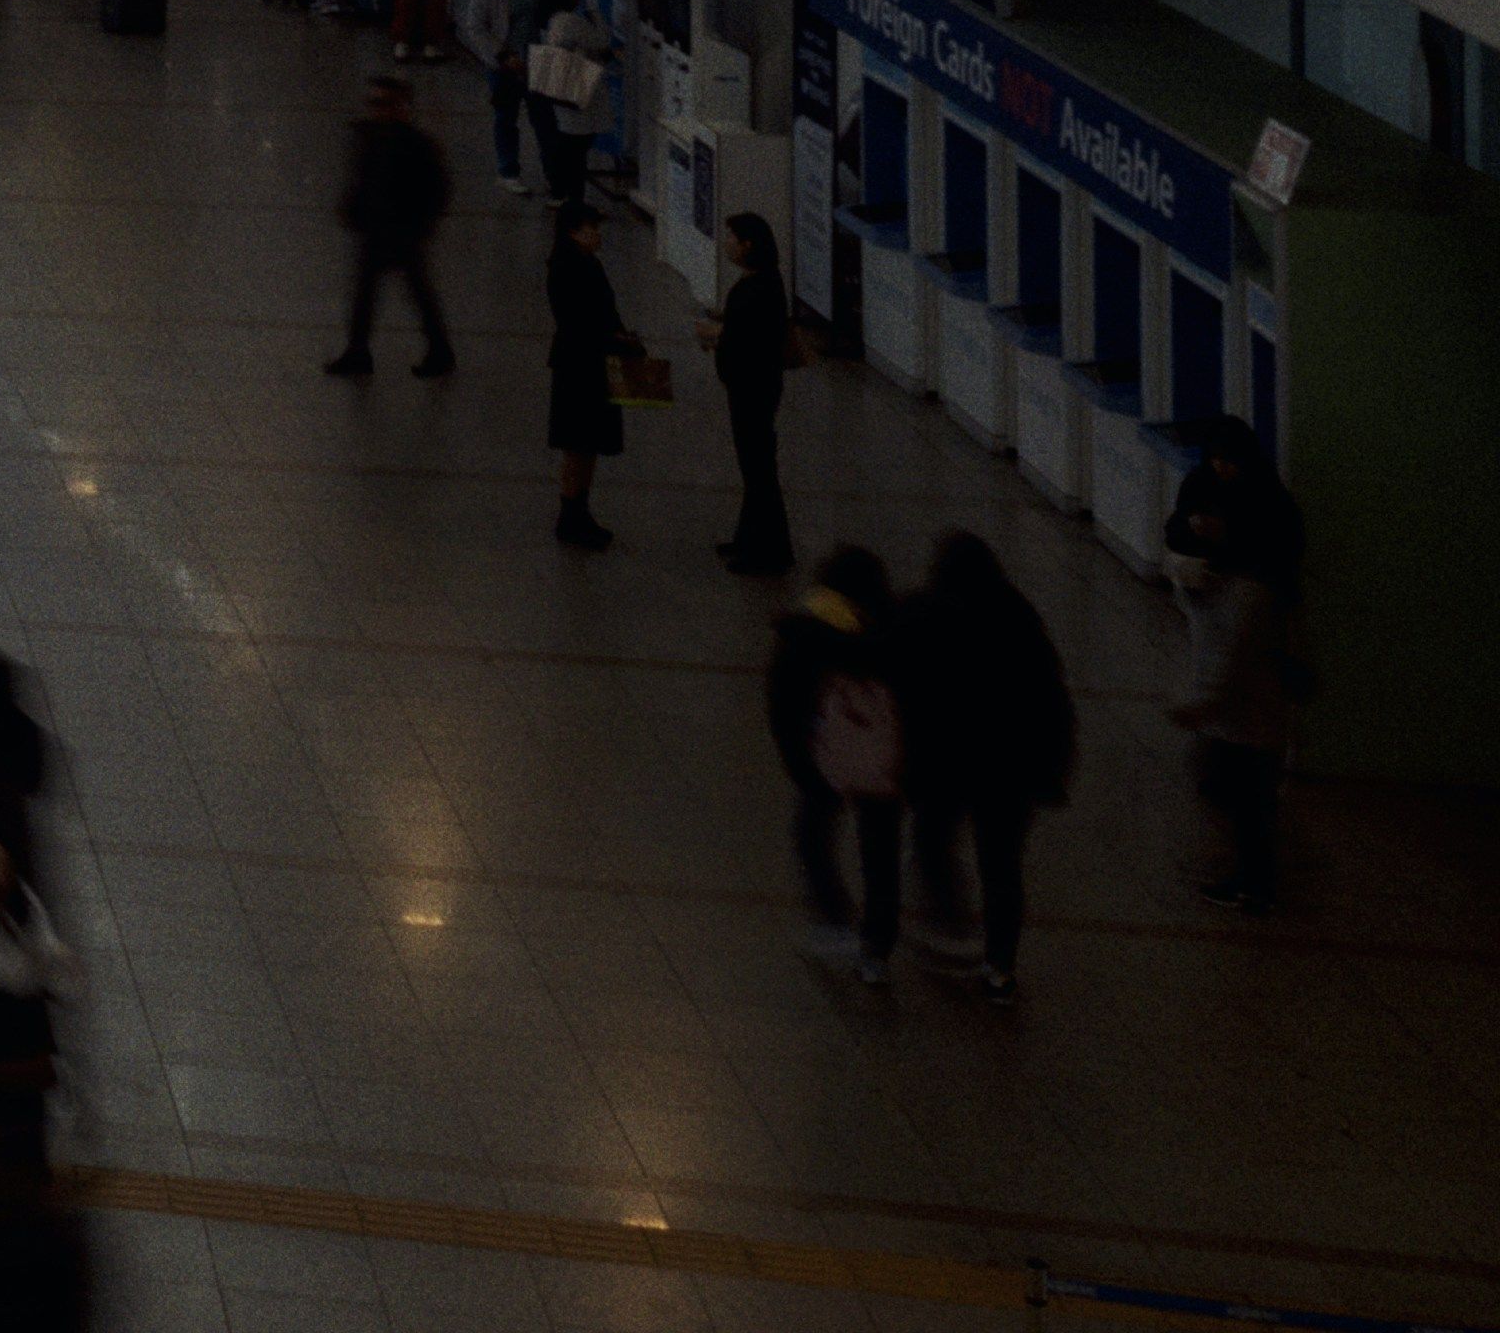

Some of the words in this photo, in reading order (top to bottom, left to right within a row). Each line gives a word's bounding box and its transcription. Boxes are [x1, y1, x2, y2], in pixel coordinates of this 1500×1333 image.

[932, 18, 996, 103] Cards
[999, 58, 1054, 137] NOT
[1059, 96, 1175, 220] Available
